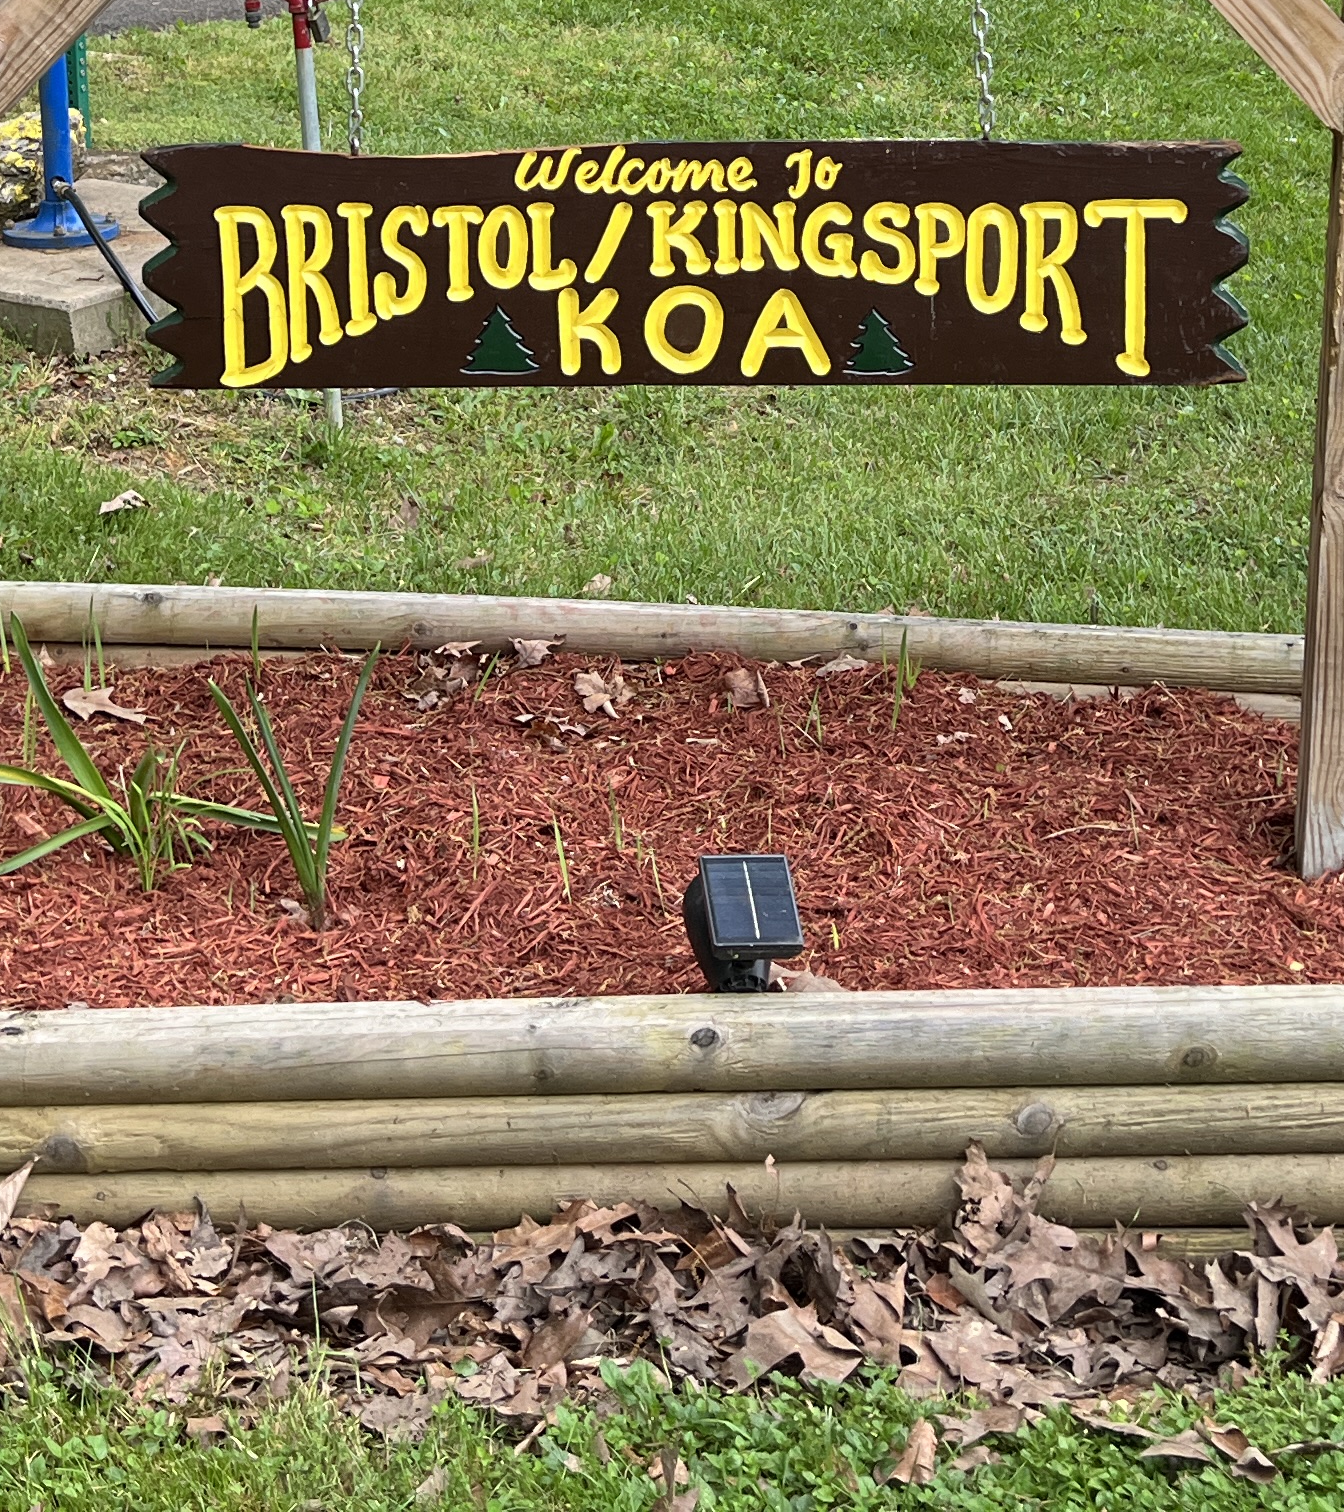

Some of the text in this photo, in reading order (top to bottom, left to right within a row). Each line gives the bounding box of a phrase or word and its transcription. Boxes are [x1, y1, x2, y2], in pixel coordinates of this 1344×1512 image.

[516, 144, 843, 198] Welcome To
[559, 285, 832, 374] KOA
